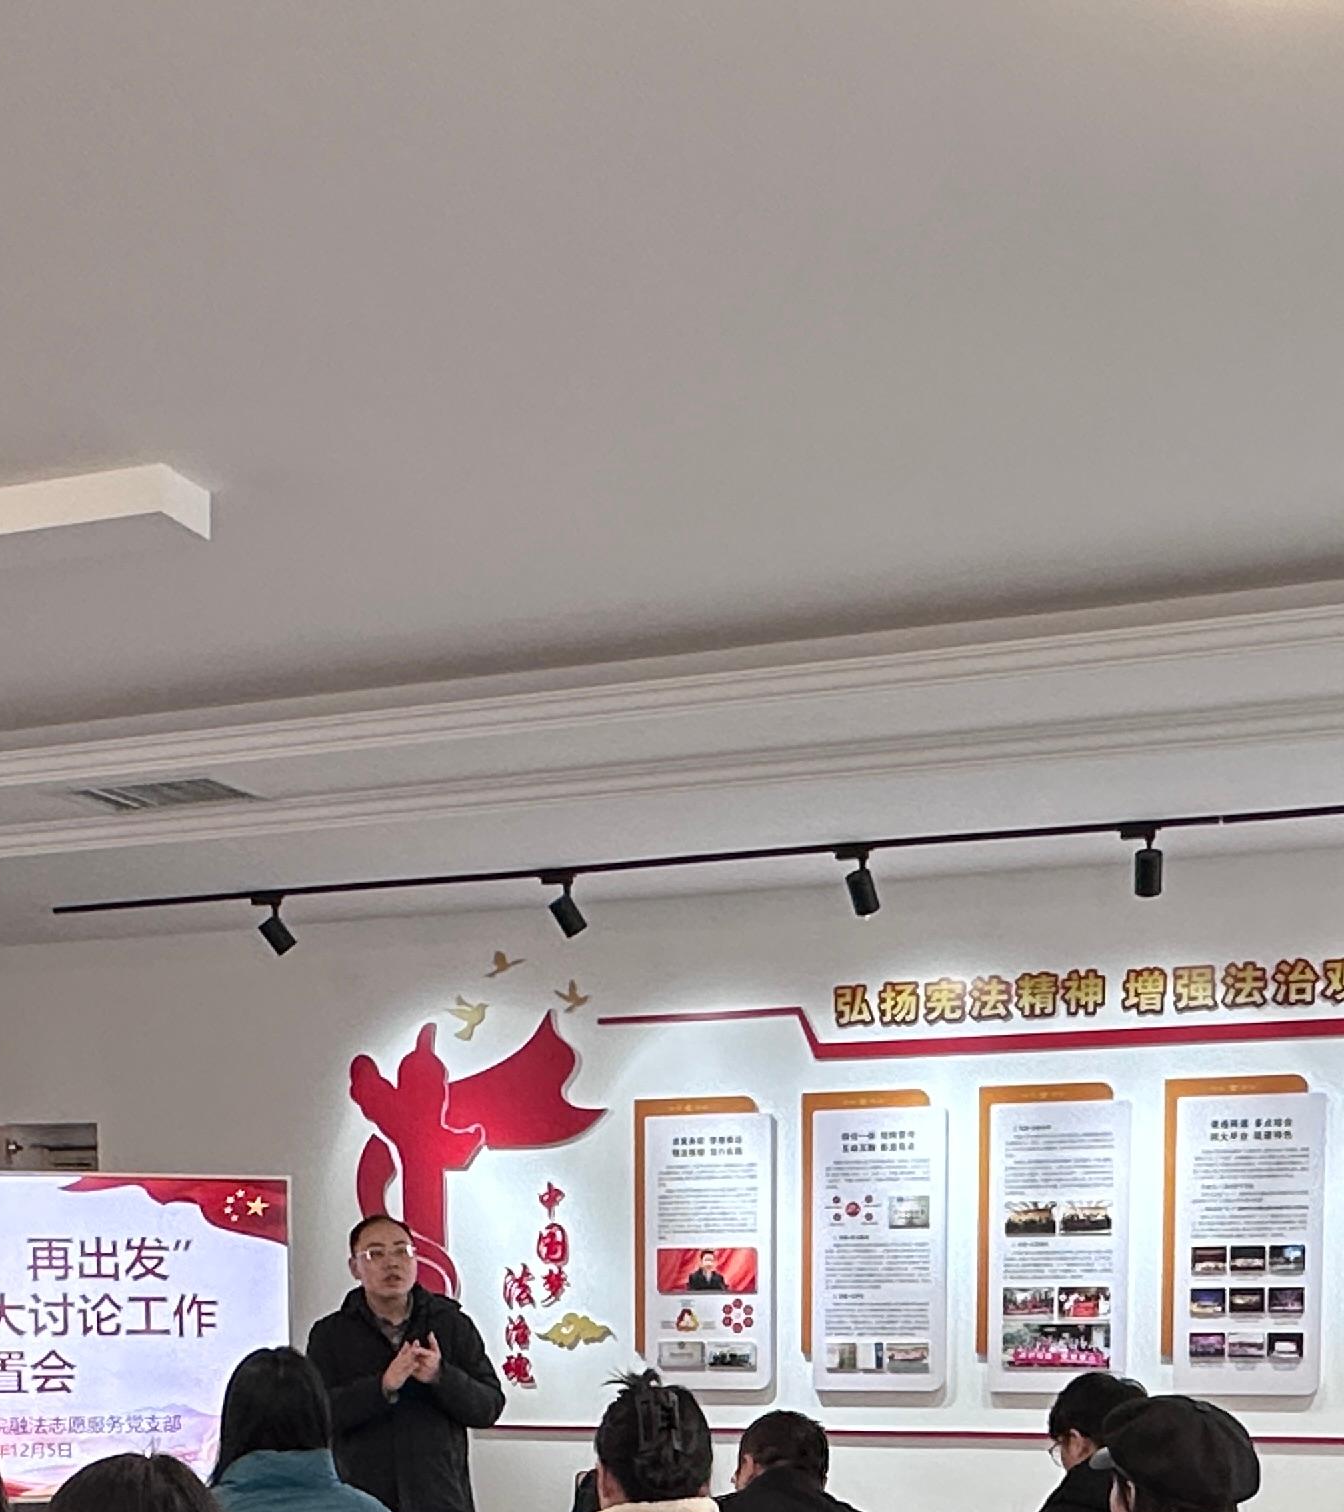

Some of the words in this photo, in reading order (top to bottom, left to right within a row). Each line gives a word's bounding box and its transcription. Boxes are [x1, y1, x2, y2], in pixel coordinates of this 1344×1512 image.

[834, 968, 1106, 1027] 弘扬宪法精神
